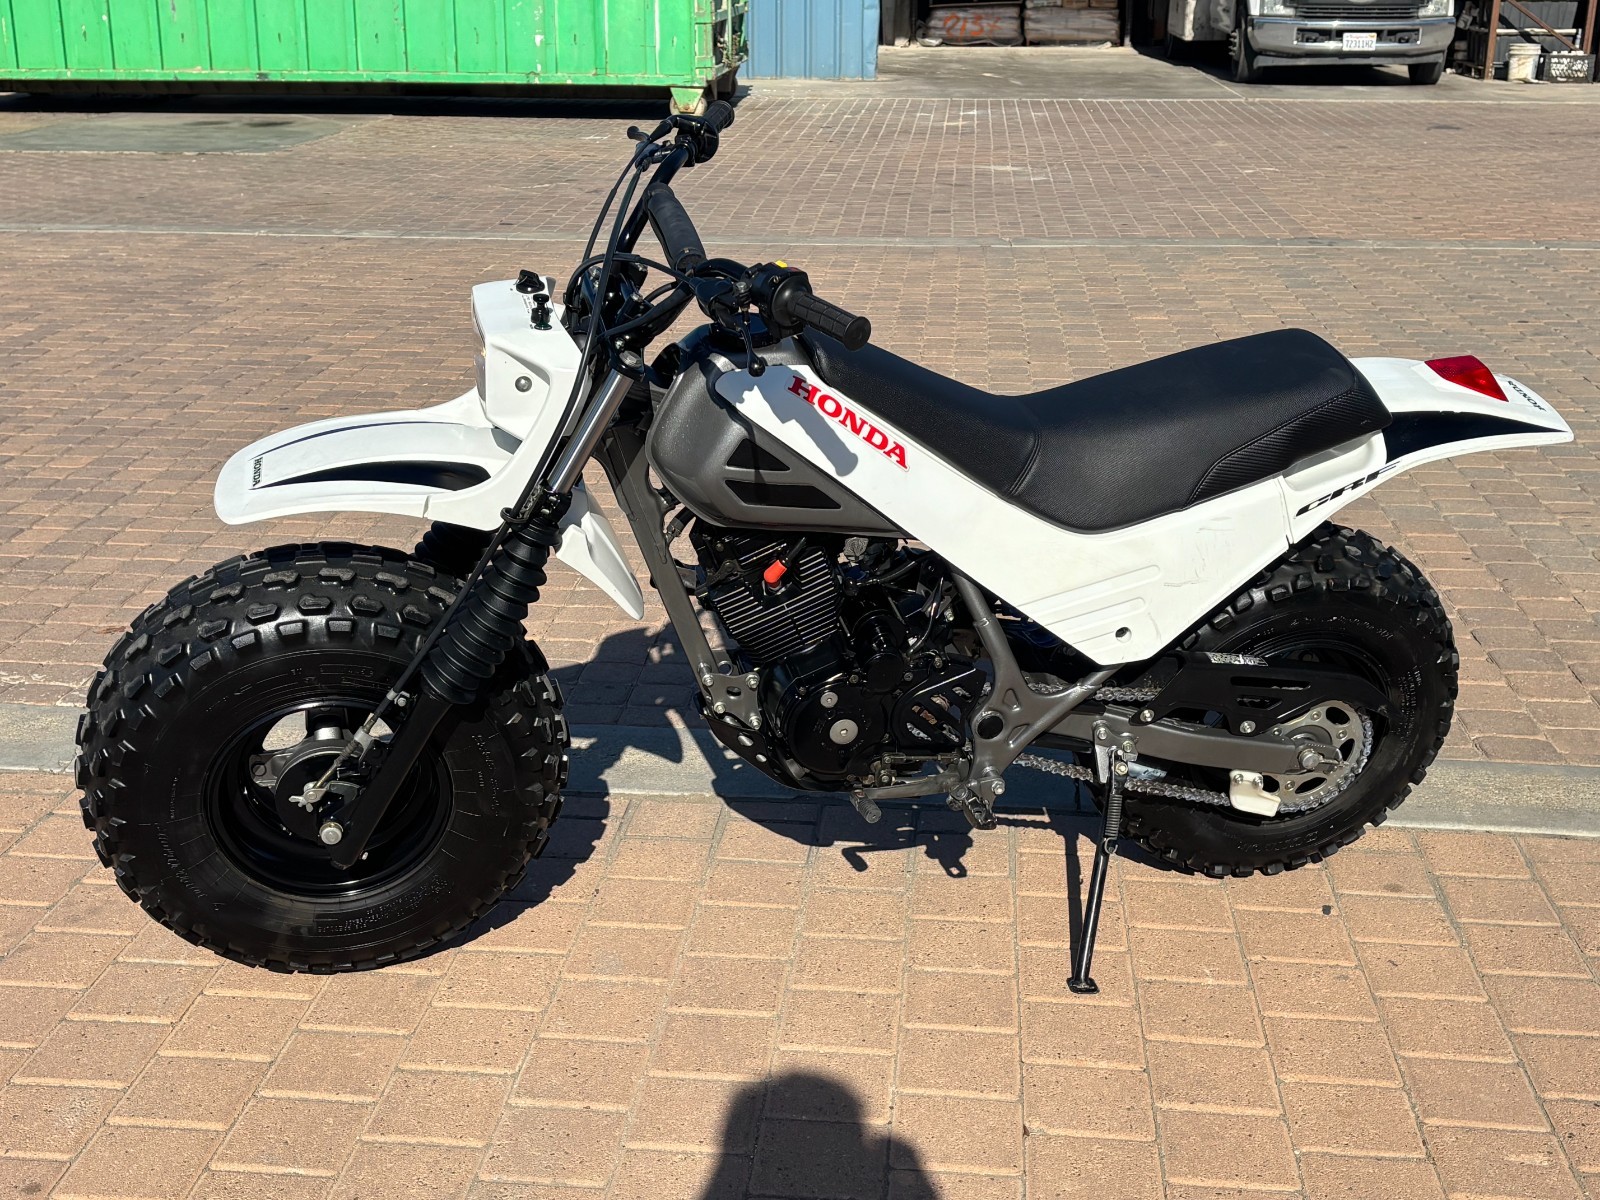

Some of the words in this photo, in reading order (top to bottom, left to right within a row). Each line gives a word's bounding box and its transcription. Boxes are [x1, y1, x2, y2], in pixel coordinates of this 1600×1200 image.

[1508, 380, 1547, 412] HONDA
[788, 375, 907, 470] HONDA
[253, 457, 263, 487] HONDA
[1295, 461, 1401, 517] CRF
